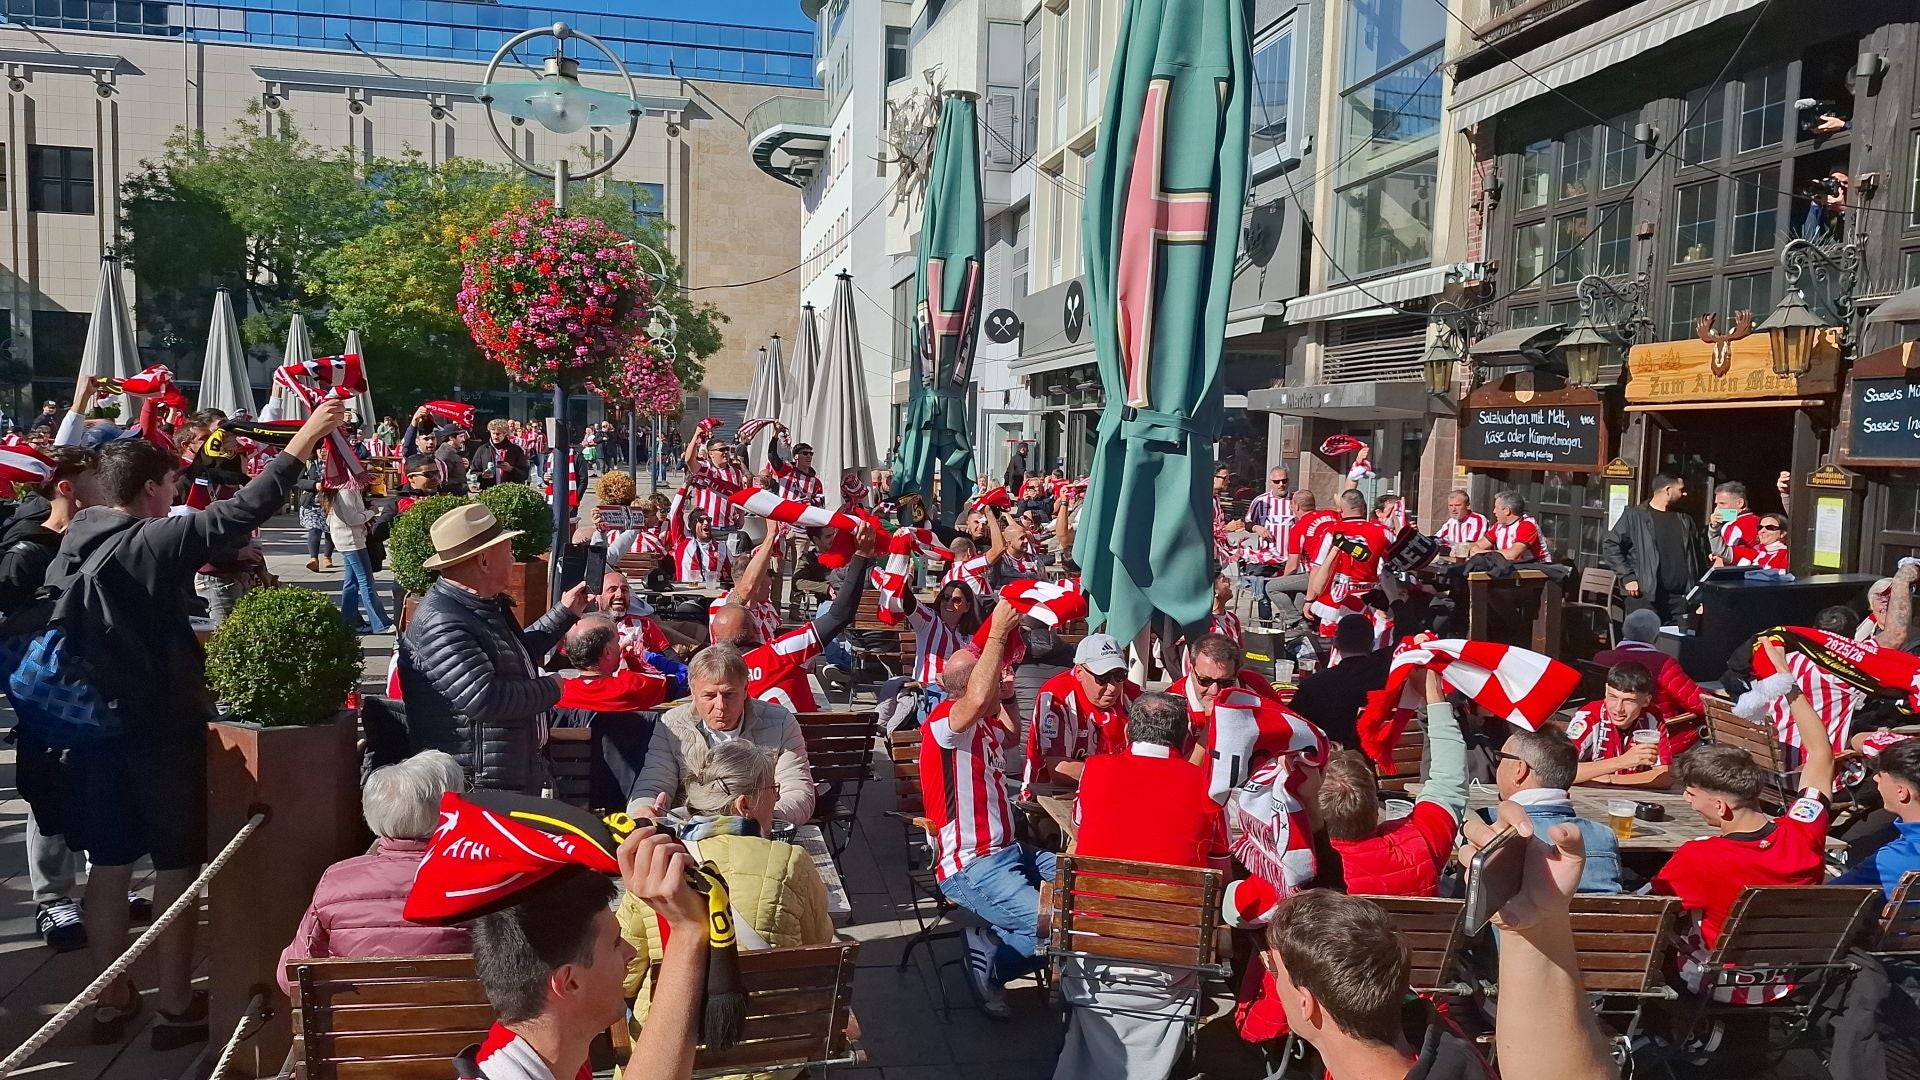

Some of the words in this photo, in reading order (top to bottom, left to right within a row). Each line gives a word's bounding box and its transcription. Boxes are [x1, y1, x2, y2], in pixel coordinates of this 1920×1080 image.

[1649, 376, 1685, 396] Zum
[1691, 374, 1738, 393] Alten
[1744, 369, 1799, 391] Mark
[1863, 387, 1903, 402] Sasse's
[1479, 409, 1530, 425] Salzkuchen
[1531, 409, 1545, 425] mit
[1863, 417, 1900, 433] Sasse's
[1485, 431, 1505, 445] Käse
[1507, 428, 1526, 444] oder
[1823, 636, 1866, 663] 2025/26
